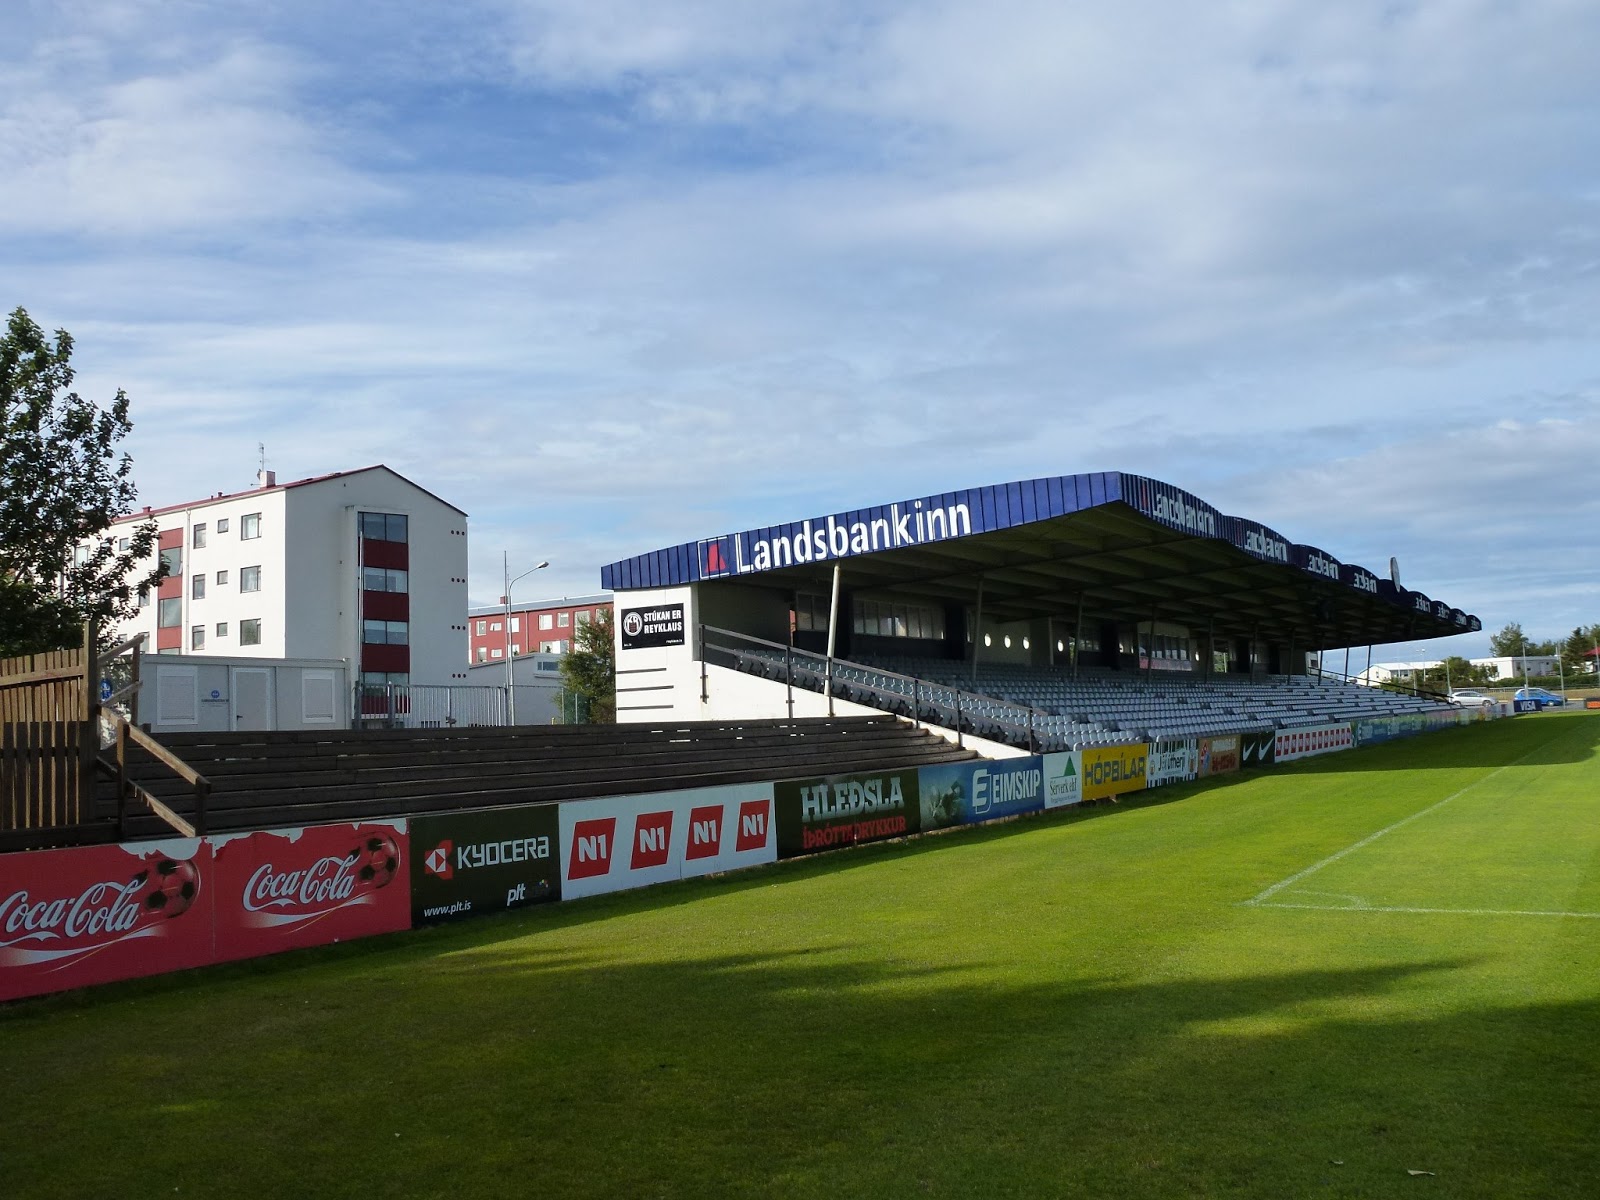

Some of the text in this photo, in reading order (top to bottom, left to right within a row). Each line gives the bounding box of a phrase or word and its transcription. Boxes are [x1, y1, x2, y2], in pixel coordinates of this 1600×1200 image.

[734, 500, 972, 575] Landsbankinn
[643, 609, 682, 623] STÚKAN ER
[643, 621, 682, 635] REYKLAUS
[1519, 700, 1537, 711] VISA
[1085, 752, 1146, 787] HÓPBÍLAR
[800, 776, 905, 823] HLEÐSLA
[992, 768, 1041, 804] EIMSKIP
[639, 825, 665, 853] N1
[693, 818, 717, 844] N1
[742, 813, 765, 837] N1
[457, 835, 550, 870] KYOCERA
[578, 833, 607, 863] N1
[243, 850, 361, 912] Coca-Cola
[506, 882, 526, 907] plt
[0, 878, 148, 947] Coca-Cola
[423, 900, 472, 918] www.plt.is
